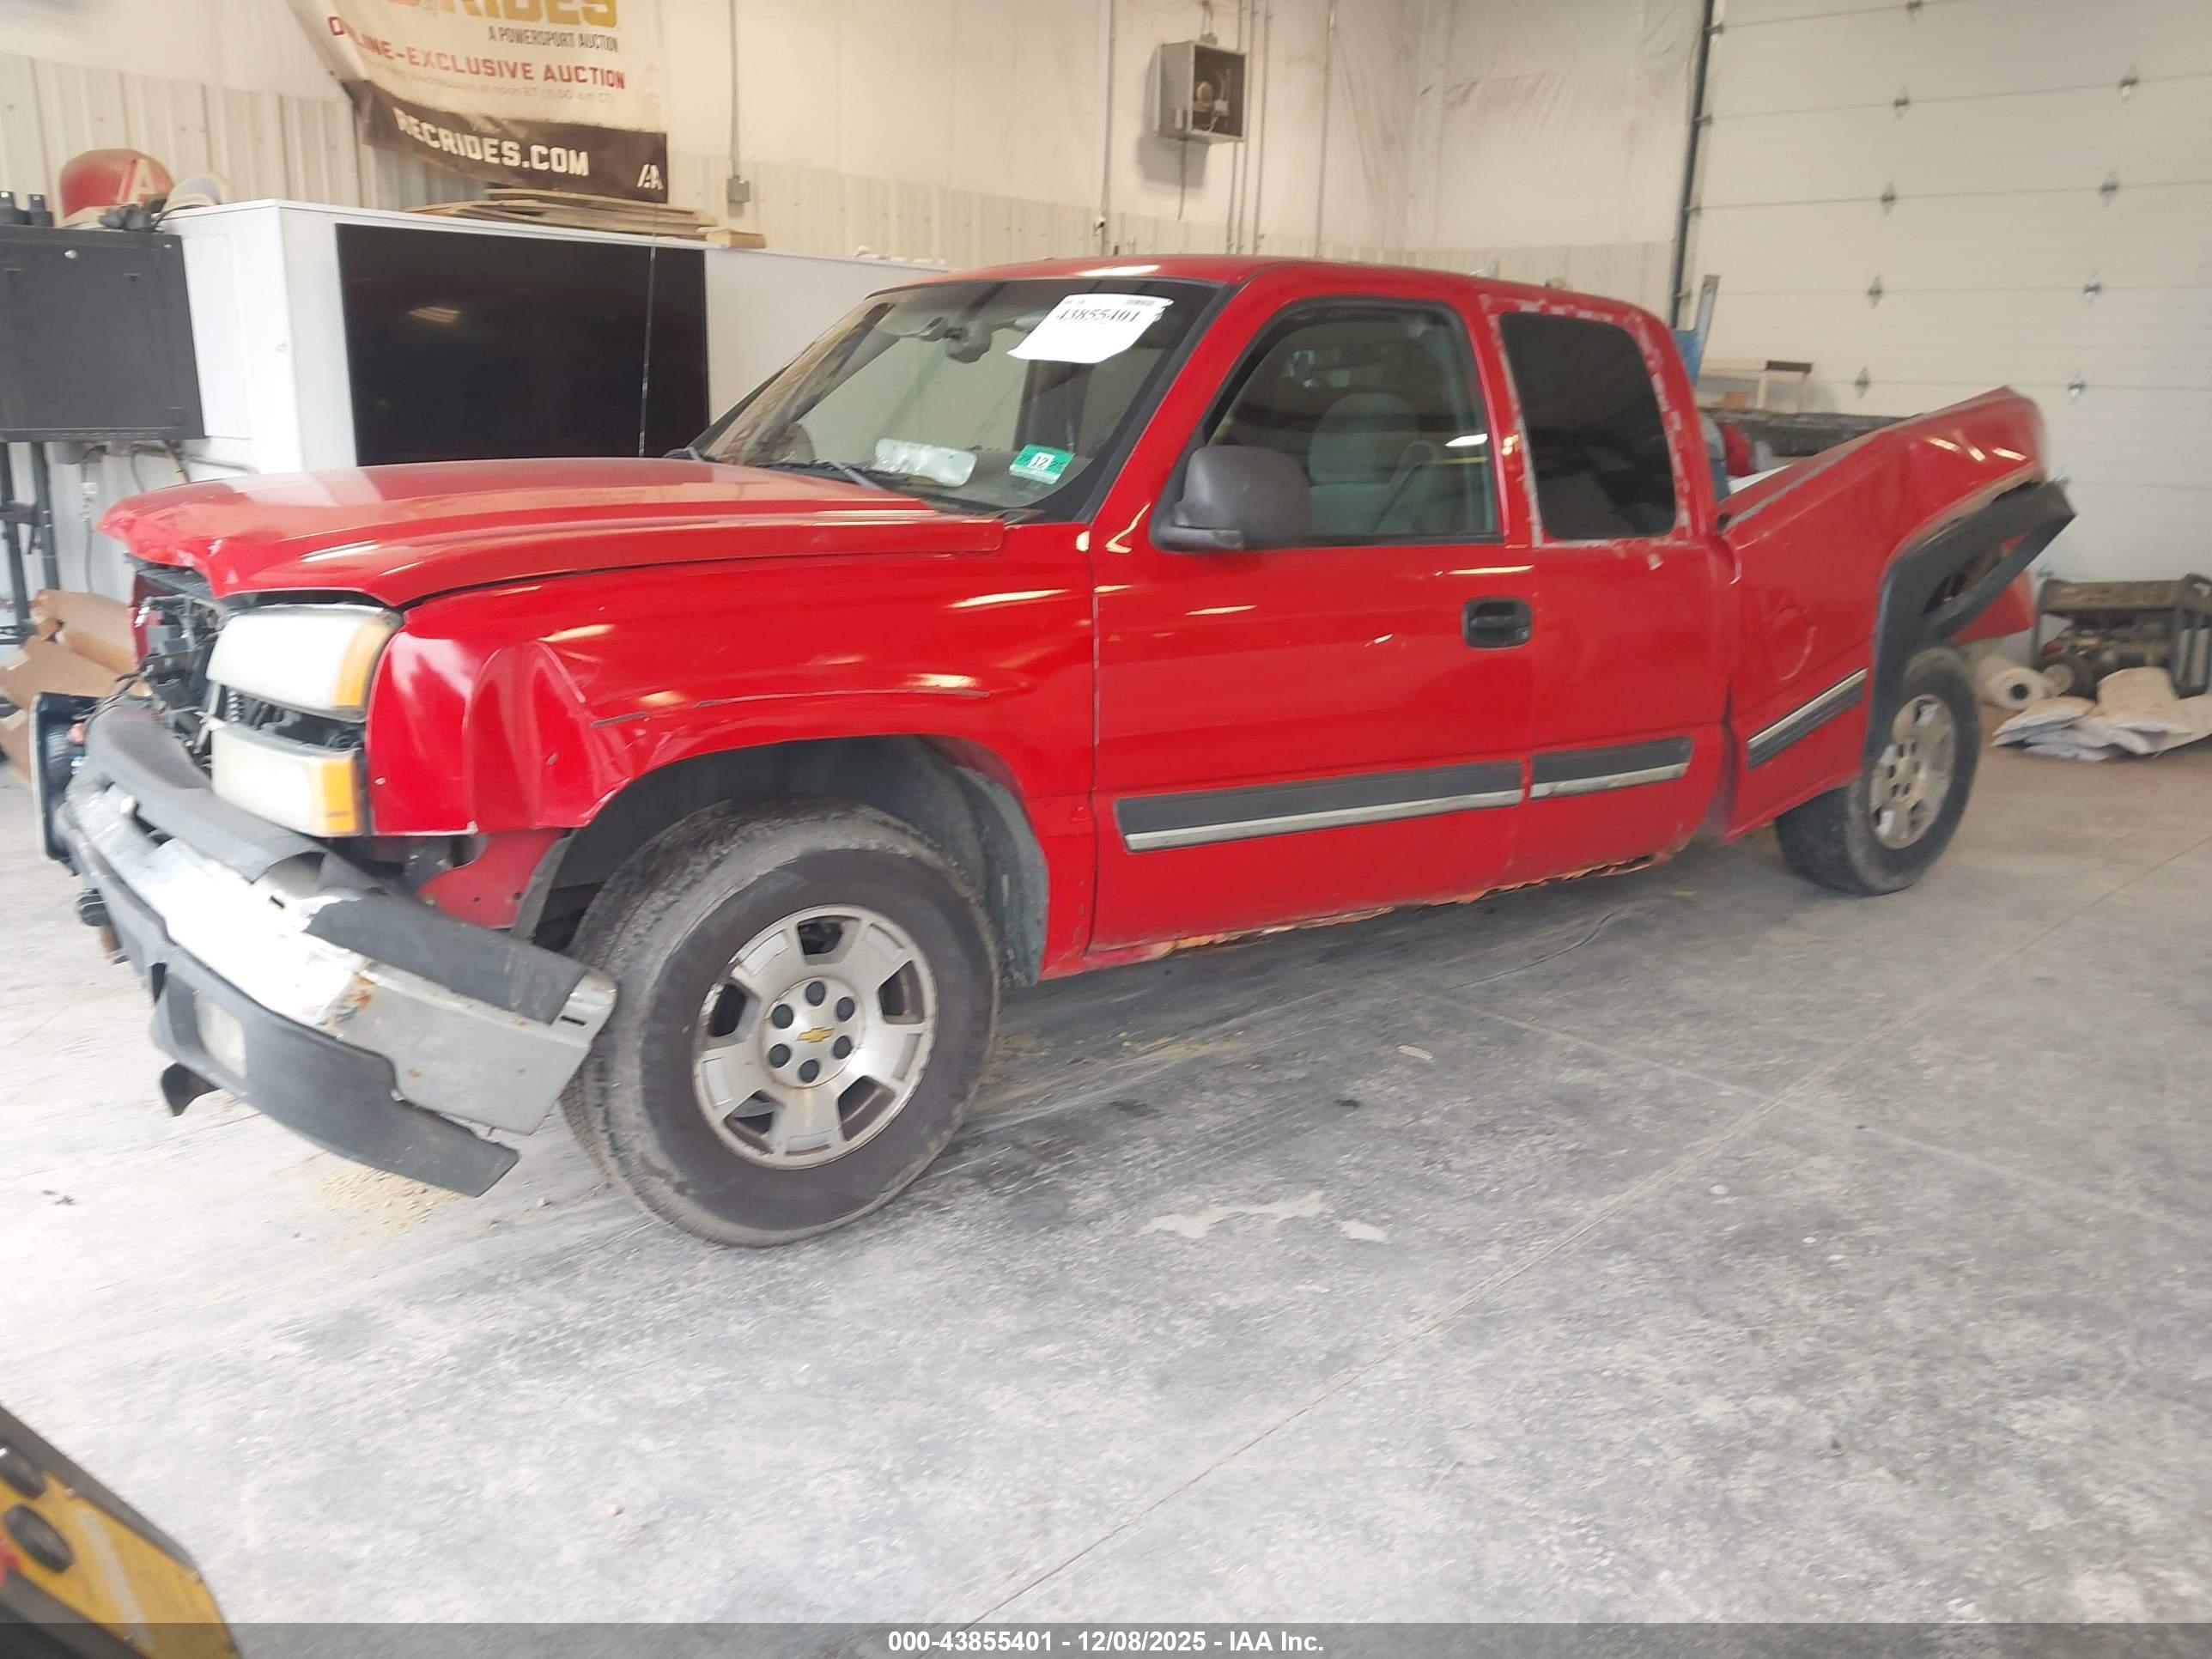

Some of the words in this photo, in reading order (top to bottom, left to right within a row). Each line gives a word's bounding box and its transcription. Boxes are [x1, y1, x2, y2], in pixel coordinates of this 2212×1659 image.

[498, 27, 575, 47] POWERSPORT
[578, 33, 618, 52] AUCTION
[543, 64, 625, 89] AUCTION
[392, 106, 590, 177] RECRIDES.COM
